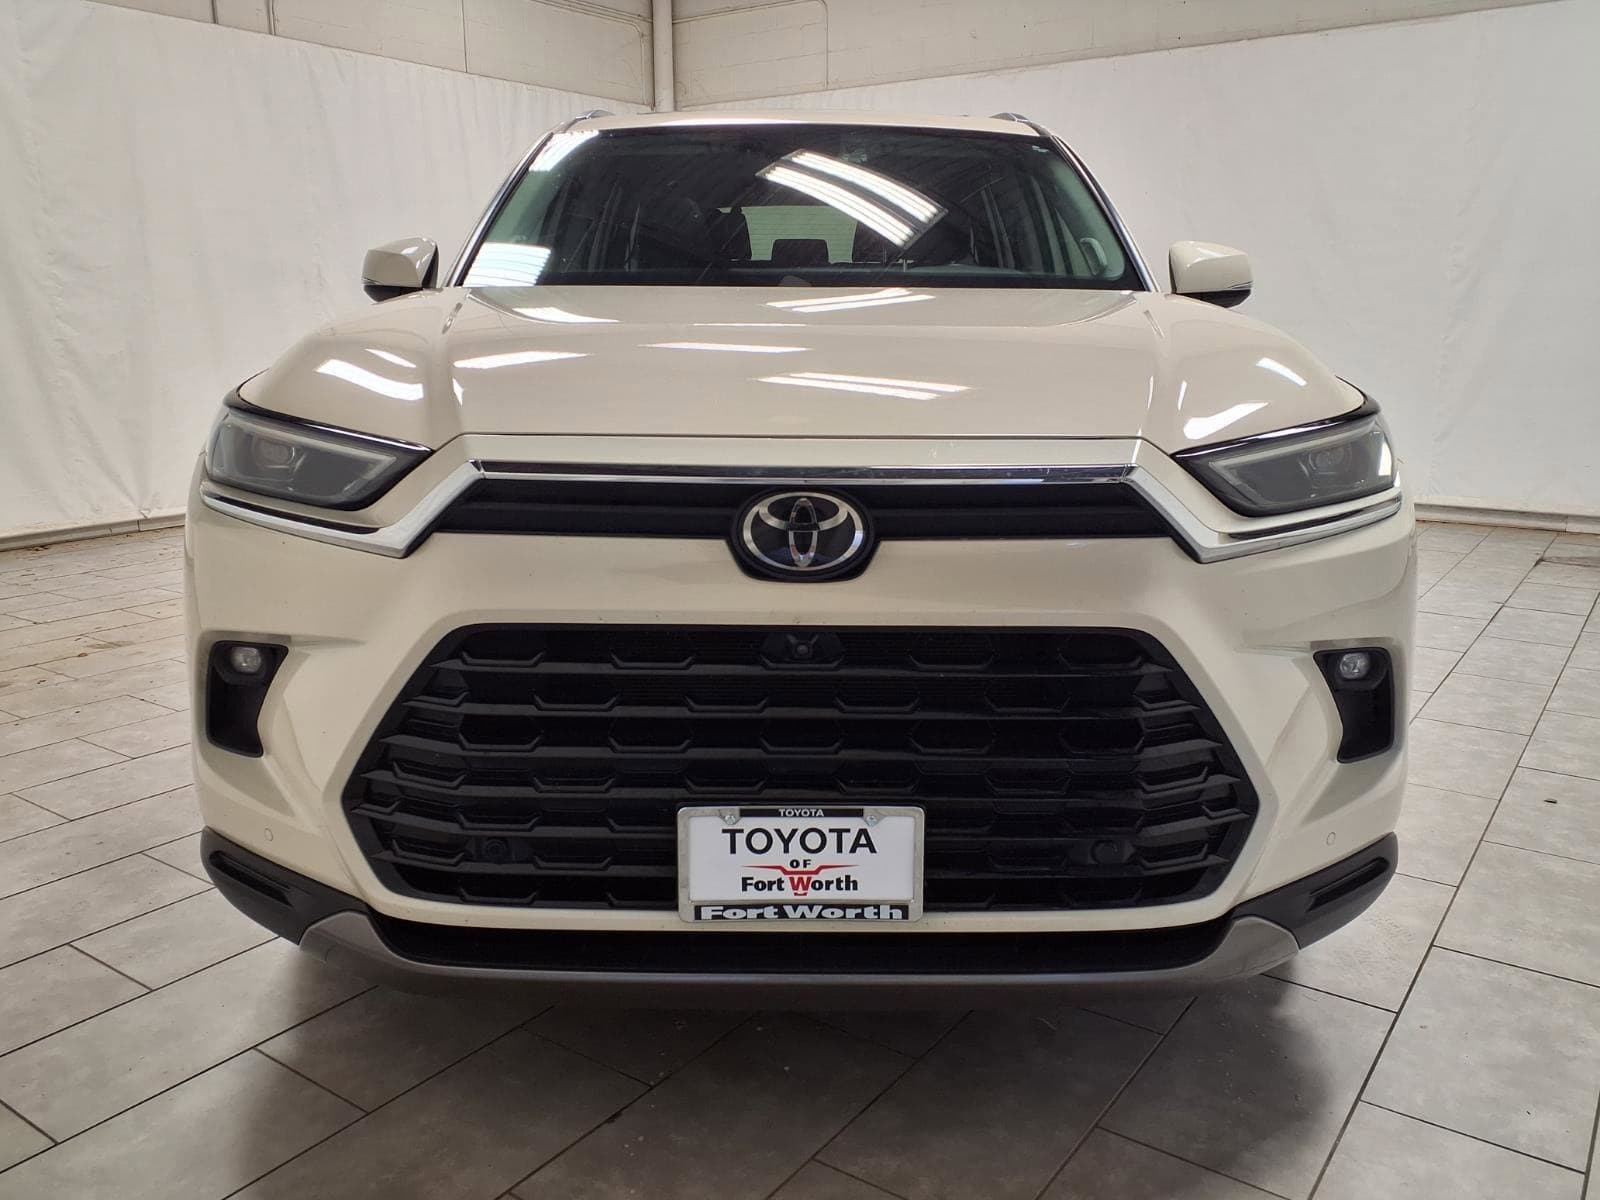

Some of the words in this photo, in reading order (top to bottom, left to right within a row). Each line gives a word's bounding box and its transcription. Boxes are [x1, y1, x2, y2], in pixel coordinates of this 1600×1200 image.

[779, 809, 824, 817] TOYOTA
[722, 827, 877, 854] TOYOTA
[789, 859, 812, 869] OF
[741, 876, 785, 892] Fort
[789, 875, 858, 892] Worth
[701, 905, 781, 919] Fort
[783, 905, 903, 919] Worth
